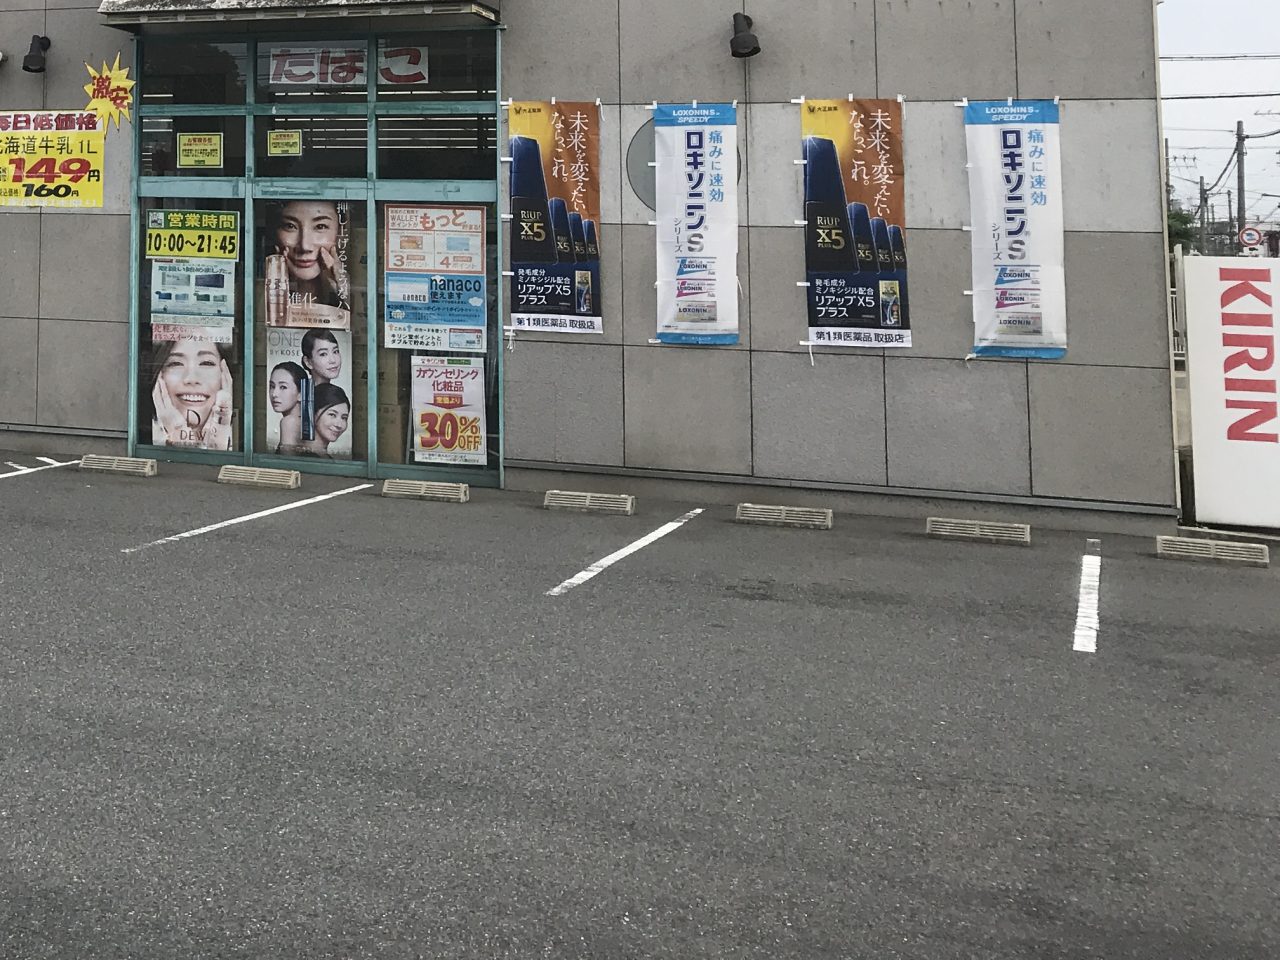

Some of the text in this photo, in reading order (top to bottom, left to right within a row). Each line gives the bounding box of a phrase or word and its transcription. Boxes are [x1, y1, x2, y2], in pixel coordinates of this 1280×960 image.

[91, 75, 130, 110] 激安
[566, 110, 590, 211] 未来を変えたい
[708, 130, 724, 203] 痛みに速効
[866, 109, 895, 217] 未来を変えたい
[1027, 128, 1047, 206] 痛みに速効
[168, 213, 235, 229] 営業時間
[420, 208, 467, 231] もっと
[520, 222, 546, 242] X5
[674, 218, 683, 253] シリーズ
[816, 229, 845, 250] X5
[991, 223, 1002, 261] シリーズ
[393, 255, 404, 267] 3
[440, 256, 451, 268] 4
[518, 268, 546, 276] 発毛成分
[430, 278, 482, 292] nanaco
[518, 276, 571, 284] ミノキシジル配合
[815, 279, 846, 287] 発毛成分
[430, 291, 463, 300] 使えます
[815, 286, 874, 295] ミノキシジル配合
[288, 292, 317, 310] 進化
[518, 294, 547, 305] プラス
[816, 307, 849, 318] プラス
[268, 330, 301, 348] ONE
[1219, 267, 1280, 443] KIRIN
[416, 367, 479, 380] カウンセリング
[431, 380, 464, 392] 化粧品
[180, 430, 207, 441] DEW
[458, 435, 481, 450] OFF
